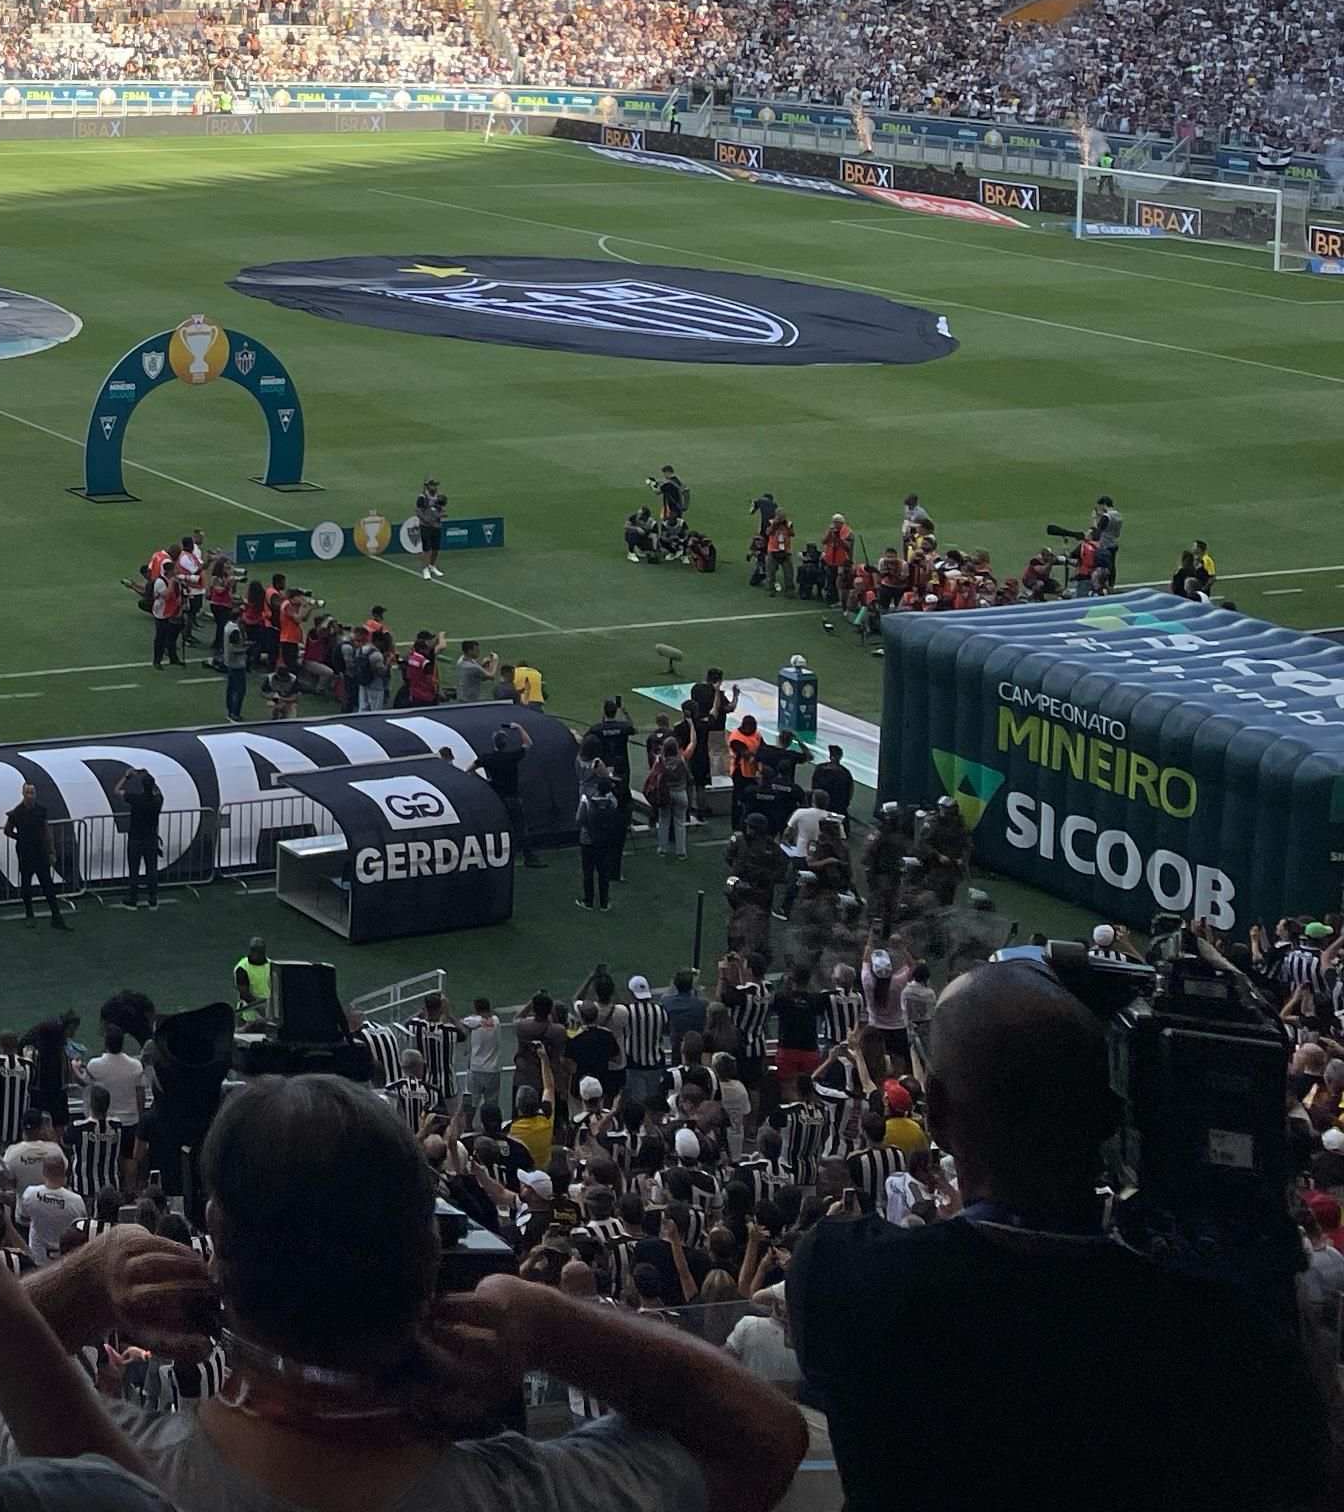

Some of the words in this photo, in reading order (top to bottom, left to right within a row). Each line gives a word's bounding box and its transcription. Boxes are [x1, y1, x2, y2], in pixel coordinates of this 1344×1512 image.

[625, 101, 658, 111] FINAL
[79, 120, 121, 138] BRAX
[212, 117, 253, 135] BRAX
[340, 115, 383, 132] BRAX
[882, 123, 912, 134] FINAL
[606, 129, 640, 151] BRAX
[1010, 136, 1041, 147] FINAL
[719, 144, 759, 169] BRAX
[845, 163, 889, 188] BRAX
[985, 184, 1035, 211] BRAX
[1141, 207, 1194, 235] BRAX
[998, 681, 1126, 741] CAMPEONATO
[998, 705, 1198, 819] MINEIRO
[354, 830, 511, 886] GERDAU
[1005, 791, 1236, 931] SICOOB
